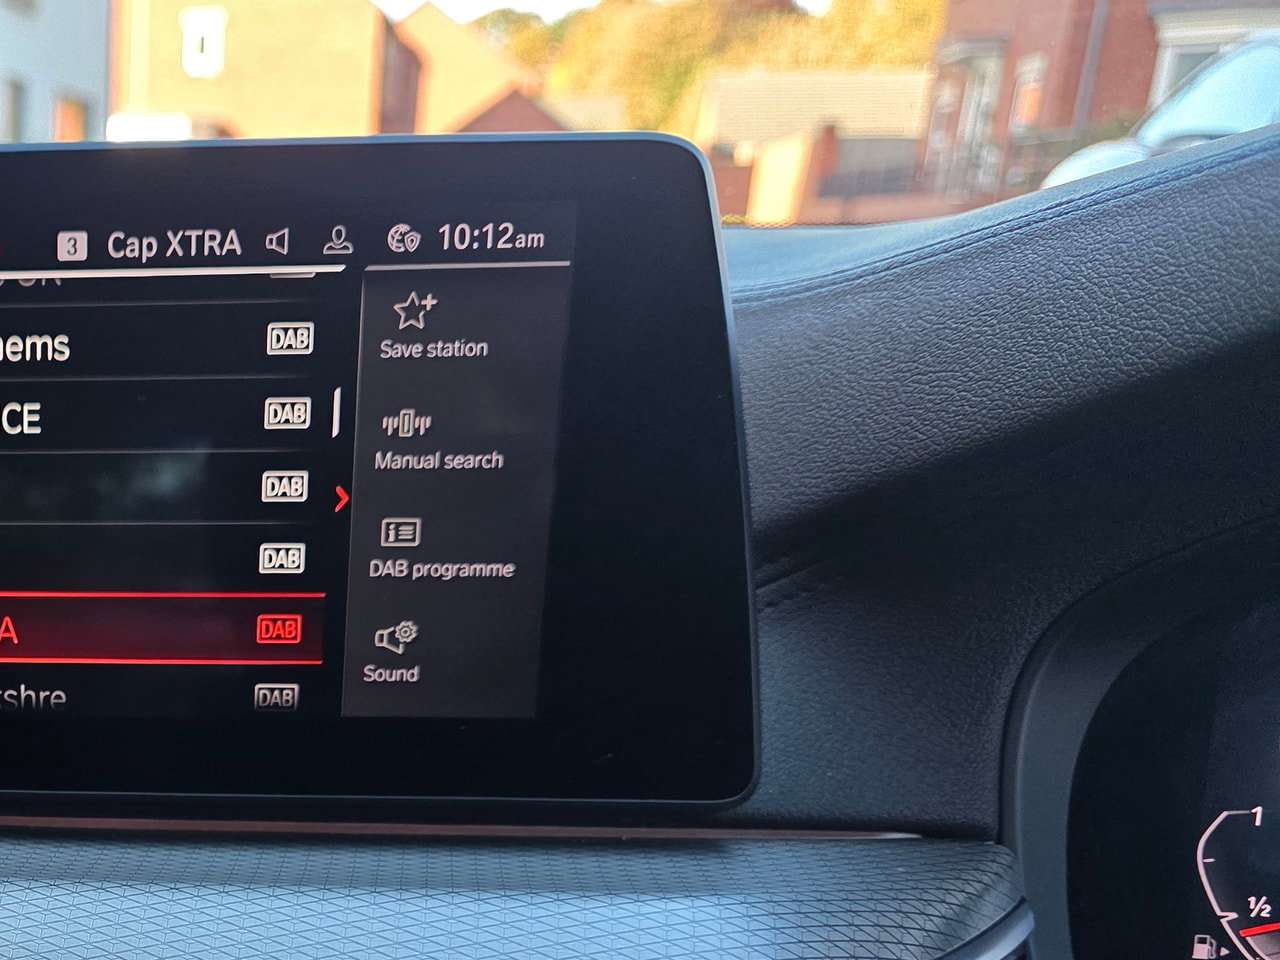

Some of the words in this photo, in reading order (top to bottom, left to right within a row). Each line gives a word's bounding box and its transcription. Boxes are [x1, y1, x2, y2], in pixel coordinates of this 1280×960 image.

[107, 231, 158, 264] Cap
[165, 228, 242, 257] XTRA
[438, 222, 545, 251] 10:12am
[271, 327, 308, 350] DAB
[379, 339, 424, 359] Save
[426, 339, 489, 358] station
[268, 402, 306, 424] DAB
[374, 450, 441, 470] Manual
[443, 450, 504, 470] search
[266, 475, 303, 498] DAB
[263, 547, 301, 570] DAB
[369, 559, 409, 578] DAB
[412, 563, 516, 581] programme
[261, 620, 297, 638] DAB
[363, 664, 420, 682] Sound
[1250, 805, 1264, 827] 1
